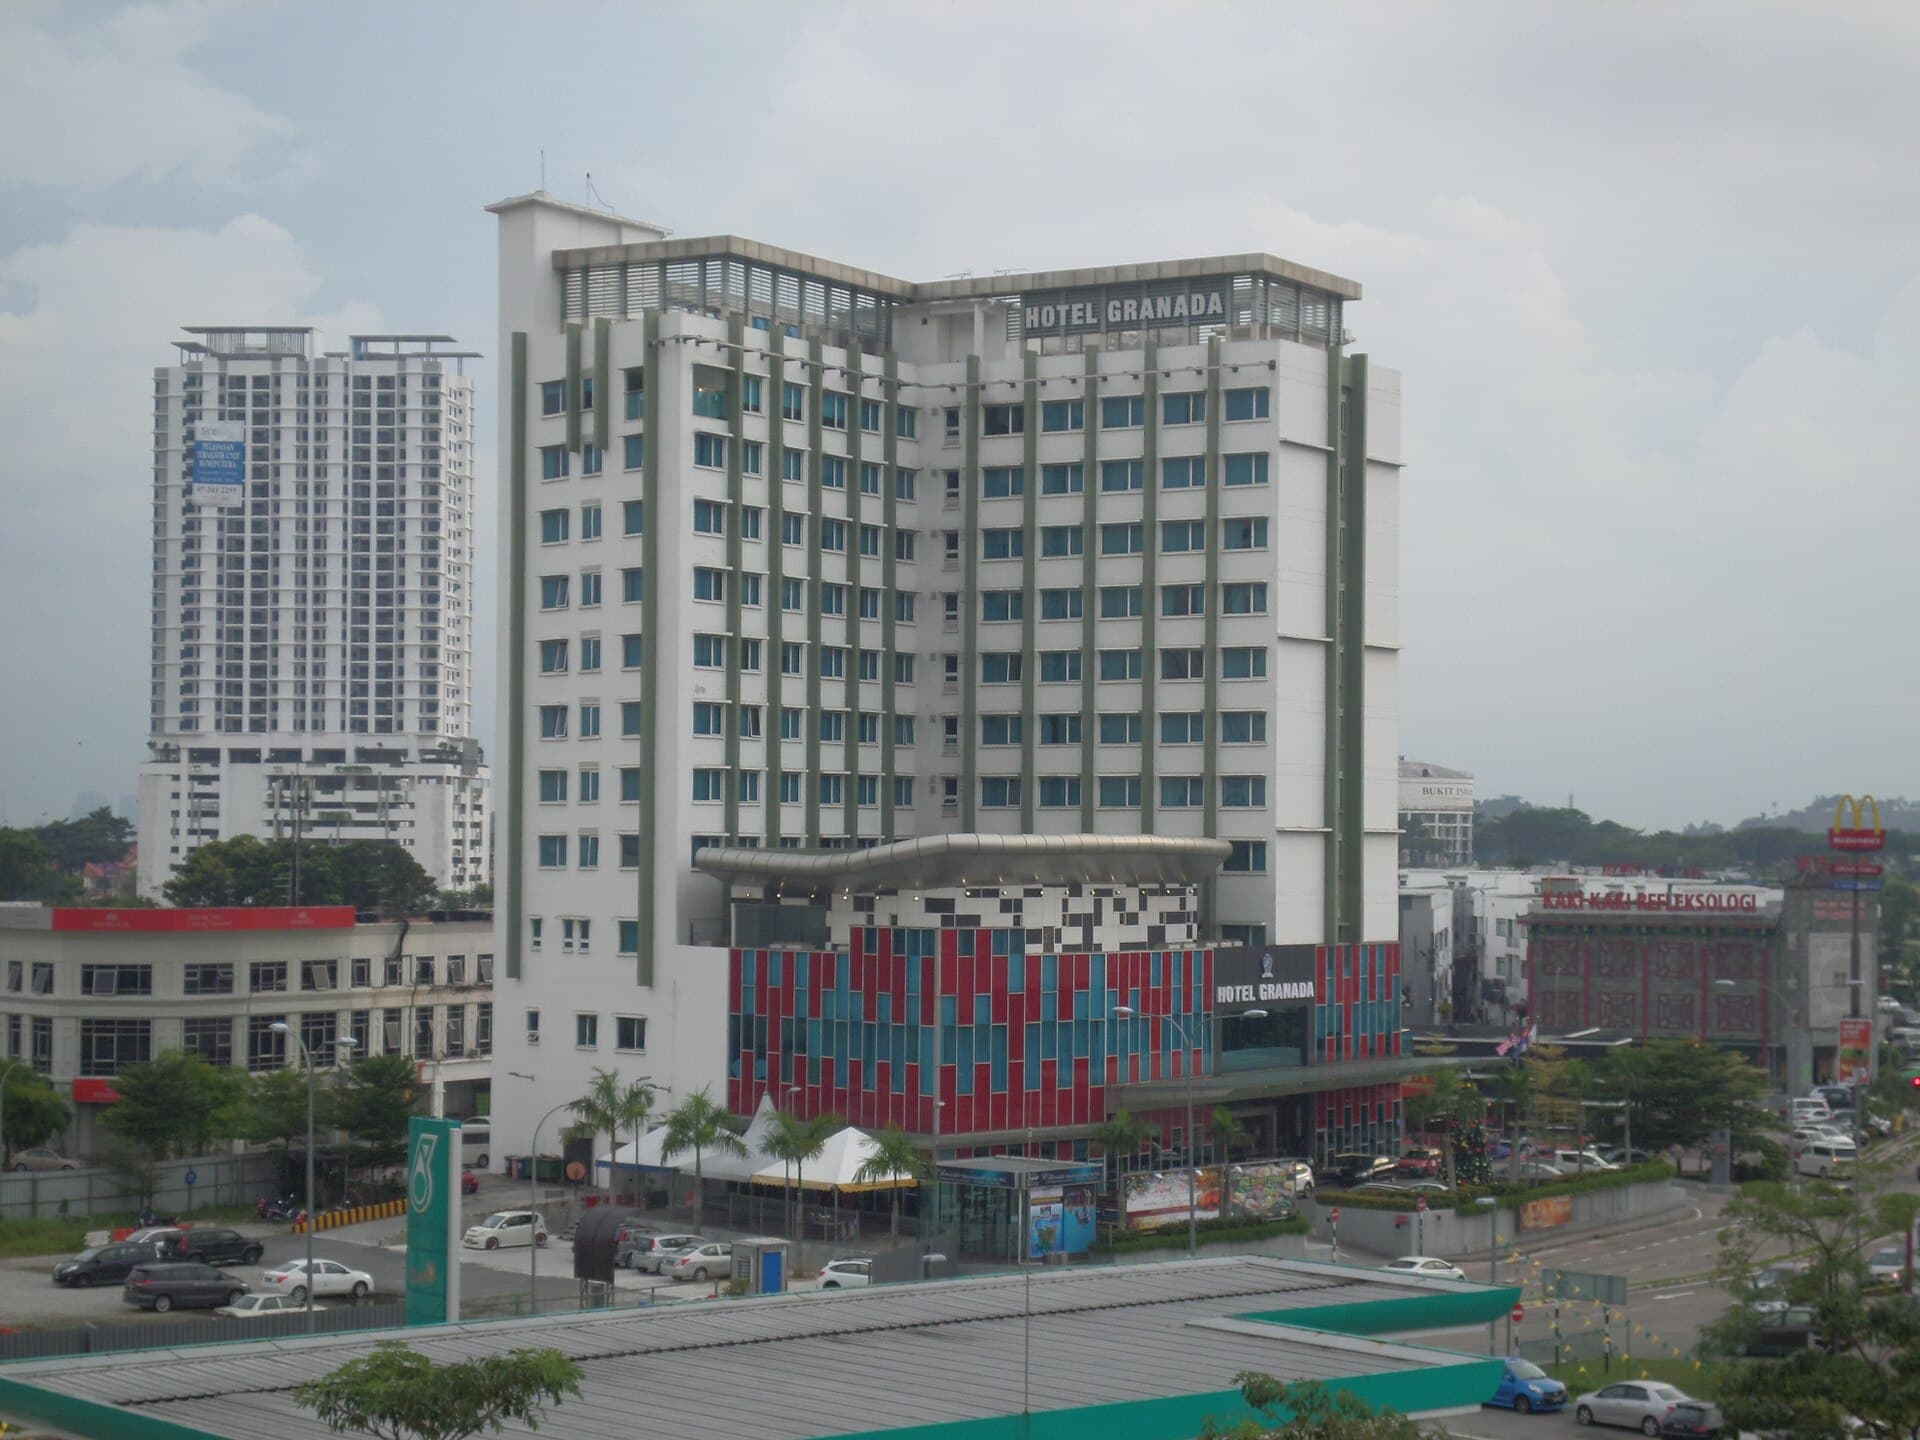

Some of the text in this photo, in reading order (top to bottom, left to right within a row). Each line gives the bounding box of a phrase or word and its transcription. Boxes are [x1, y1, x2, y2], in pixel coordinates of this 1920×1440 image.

[1025, 292, 1222, 328] HOTEL GRANADA
[1422, 786, 1454, 796] BUKIT
[1543, 891, 1757, 911] KAKI-KAKI REFLEKSOLOGI
[1217, 981, 1314, 1003] HOTEL GRANADA
